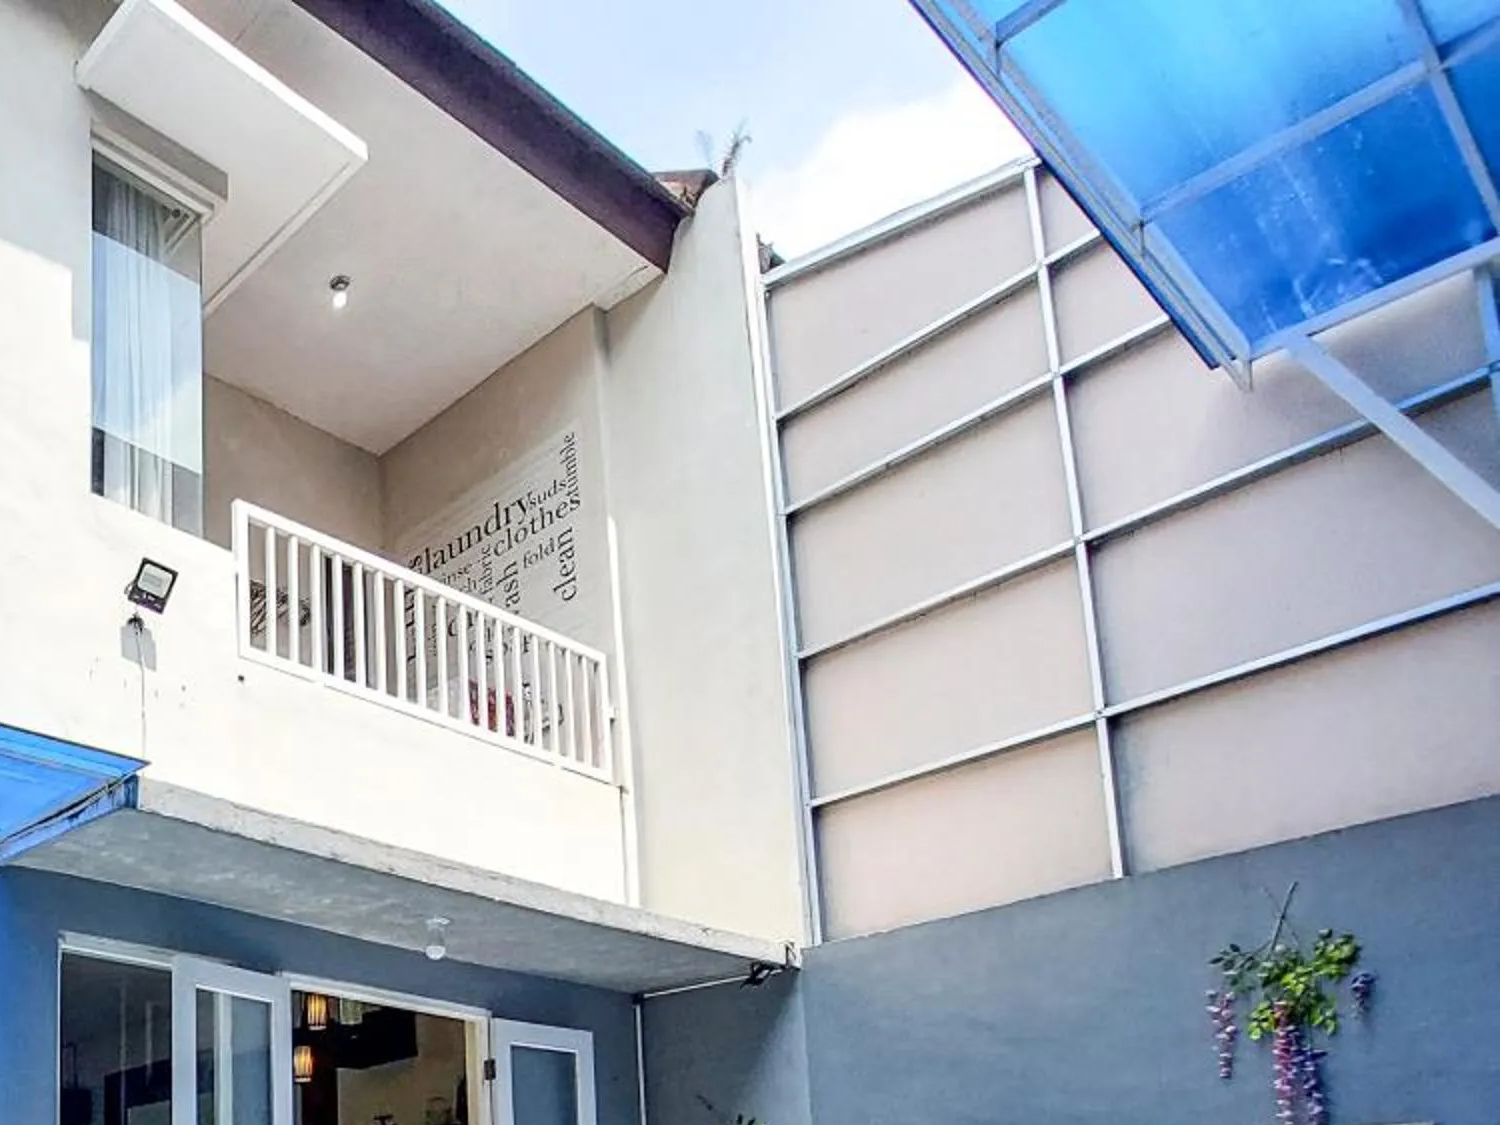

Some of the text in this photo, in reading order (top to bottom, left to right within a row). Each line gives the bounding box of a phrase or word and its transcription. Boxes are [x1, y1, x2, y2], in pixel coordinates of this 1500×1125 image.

[529, 479, 567, 510] suds
[423, 494, 534, 575] laundry
[494, 493, 581, 557] clothes
[523, 537, 557, 569] fold
[496, 560, 521, 613] ash
[553, 526, 578, 602] clean
